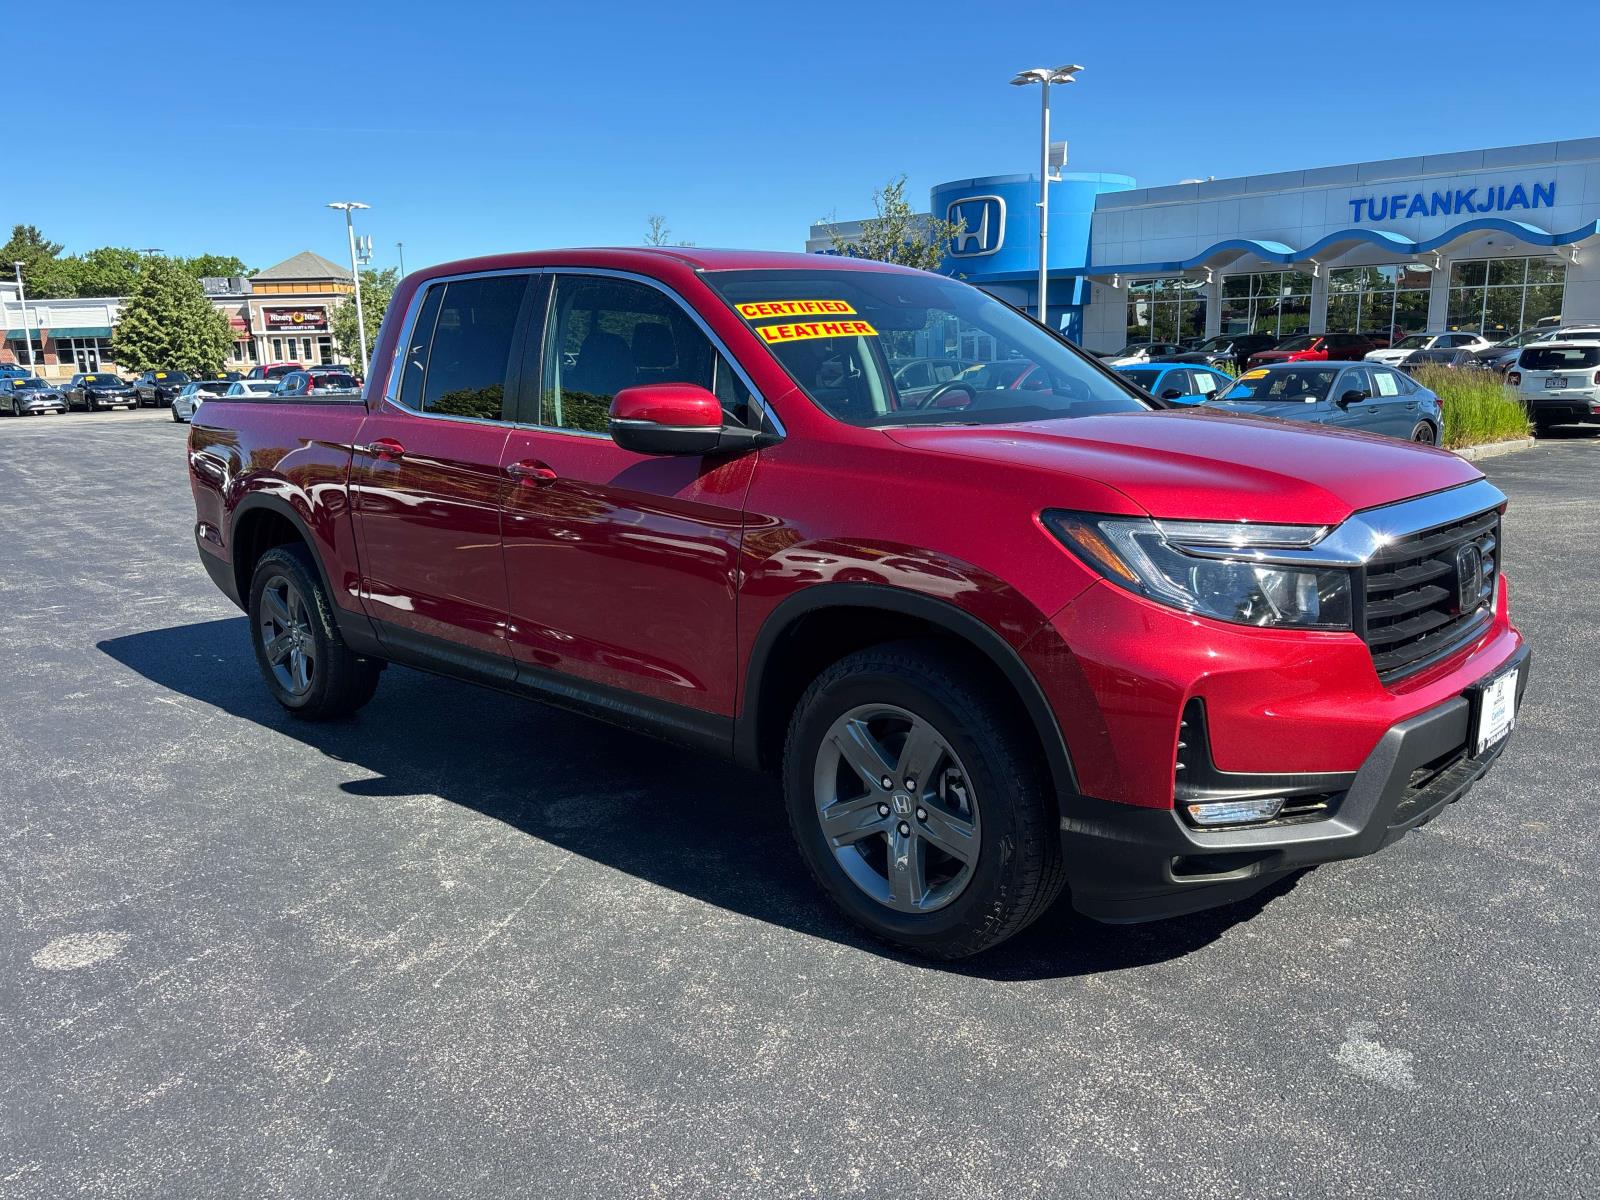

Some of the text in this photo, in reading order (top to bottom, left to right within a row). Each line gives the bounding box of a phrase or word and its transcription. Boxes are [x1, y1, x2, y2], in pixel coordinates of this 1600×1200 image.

[1349, 182, 1555, 223] TUFANKJIAN
[741, 302, 849, 317] CERTIFIED
[762, 322, 873, 341] LEATHER
